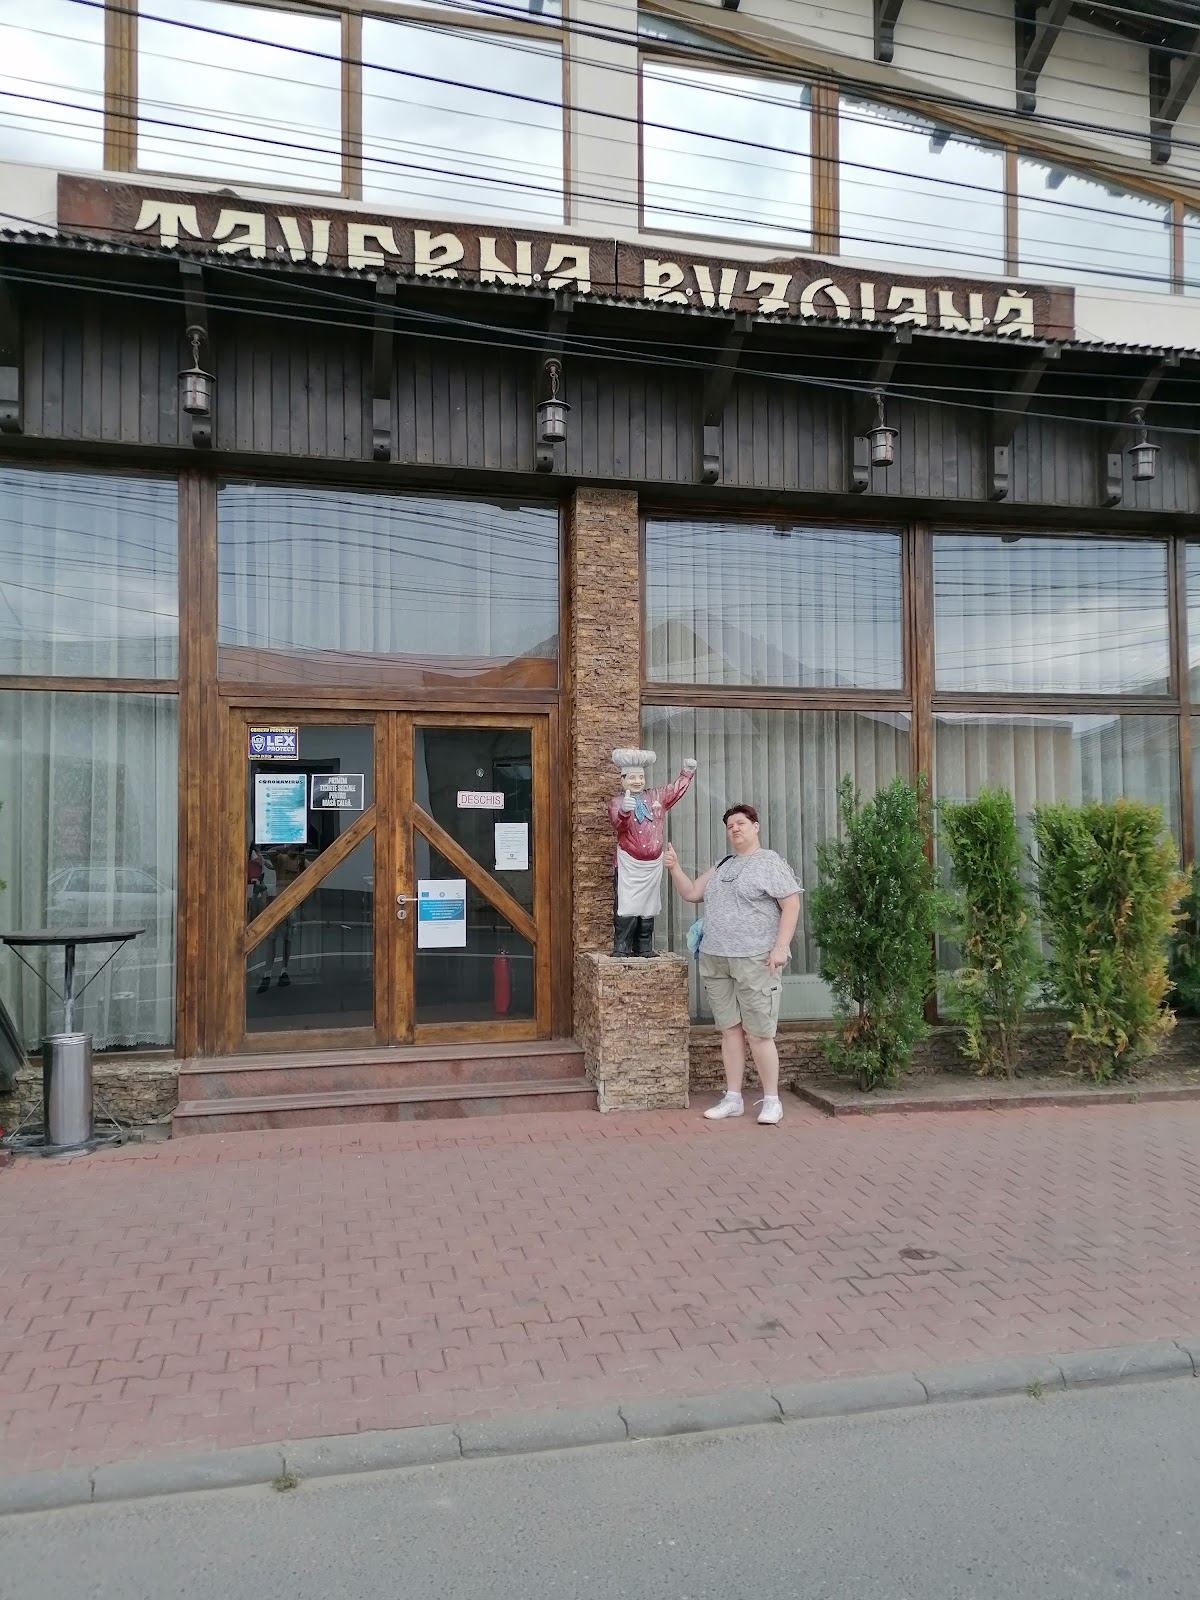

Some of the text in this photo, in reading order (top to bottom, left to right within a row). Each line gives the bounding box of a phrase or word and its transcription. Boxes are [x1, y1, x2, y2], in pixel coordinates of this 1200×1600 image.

[134, 199, 591, 294] TAVERNA
[266, 735, 295, 746] LEX
[461, 794, 501, 805] DESCHIS
